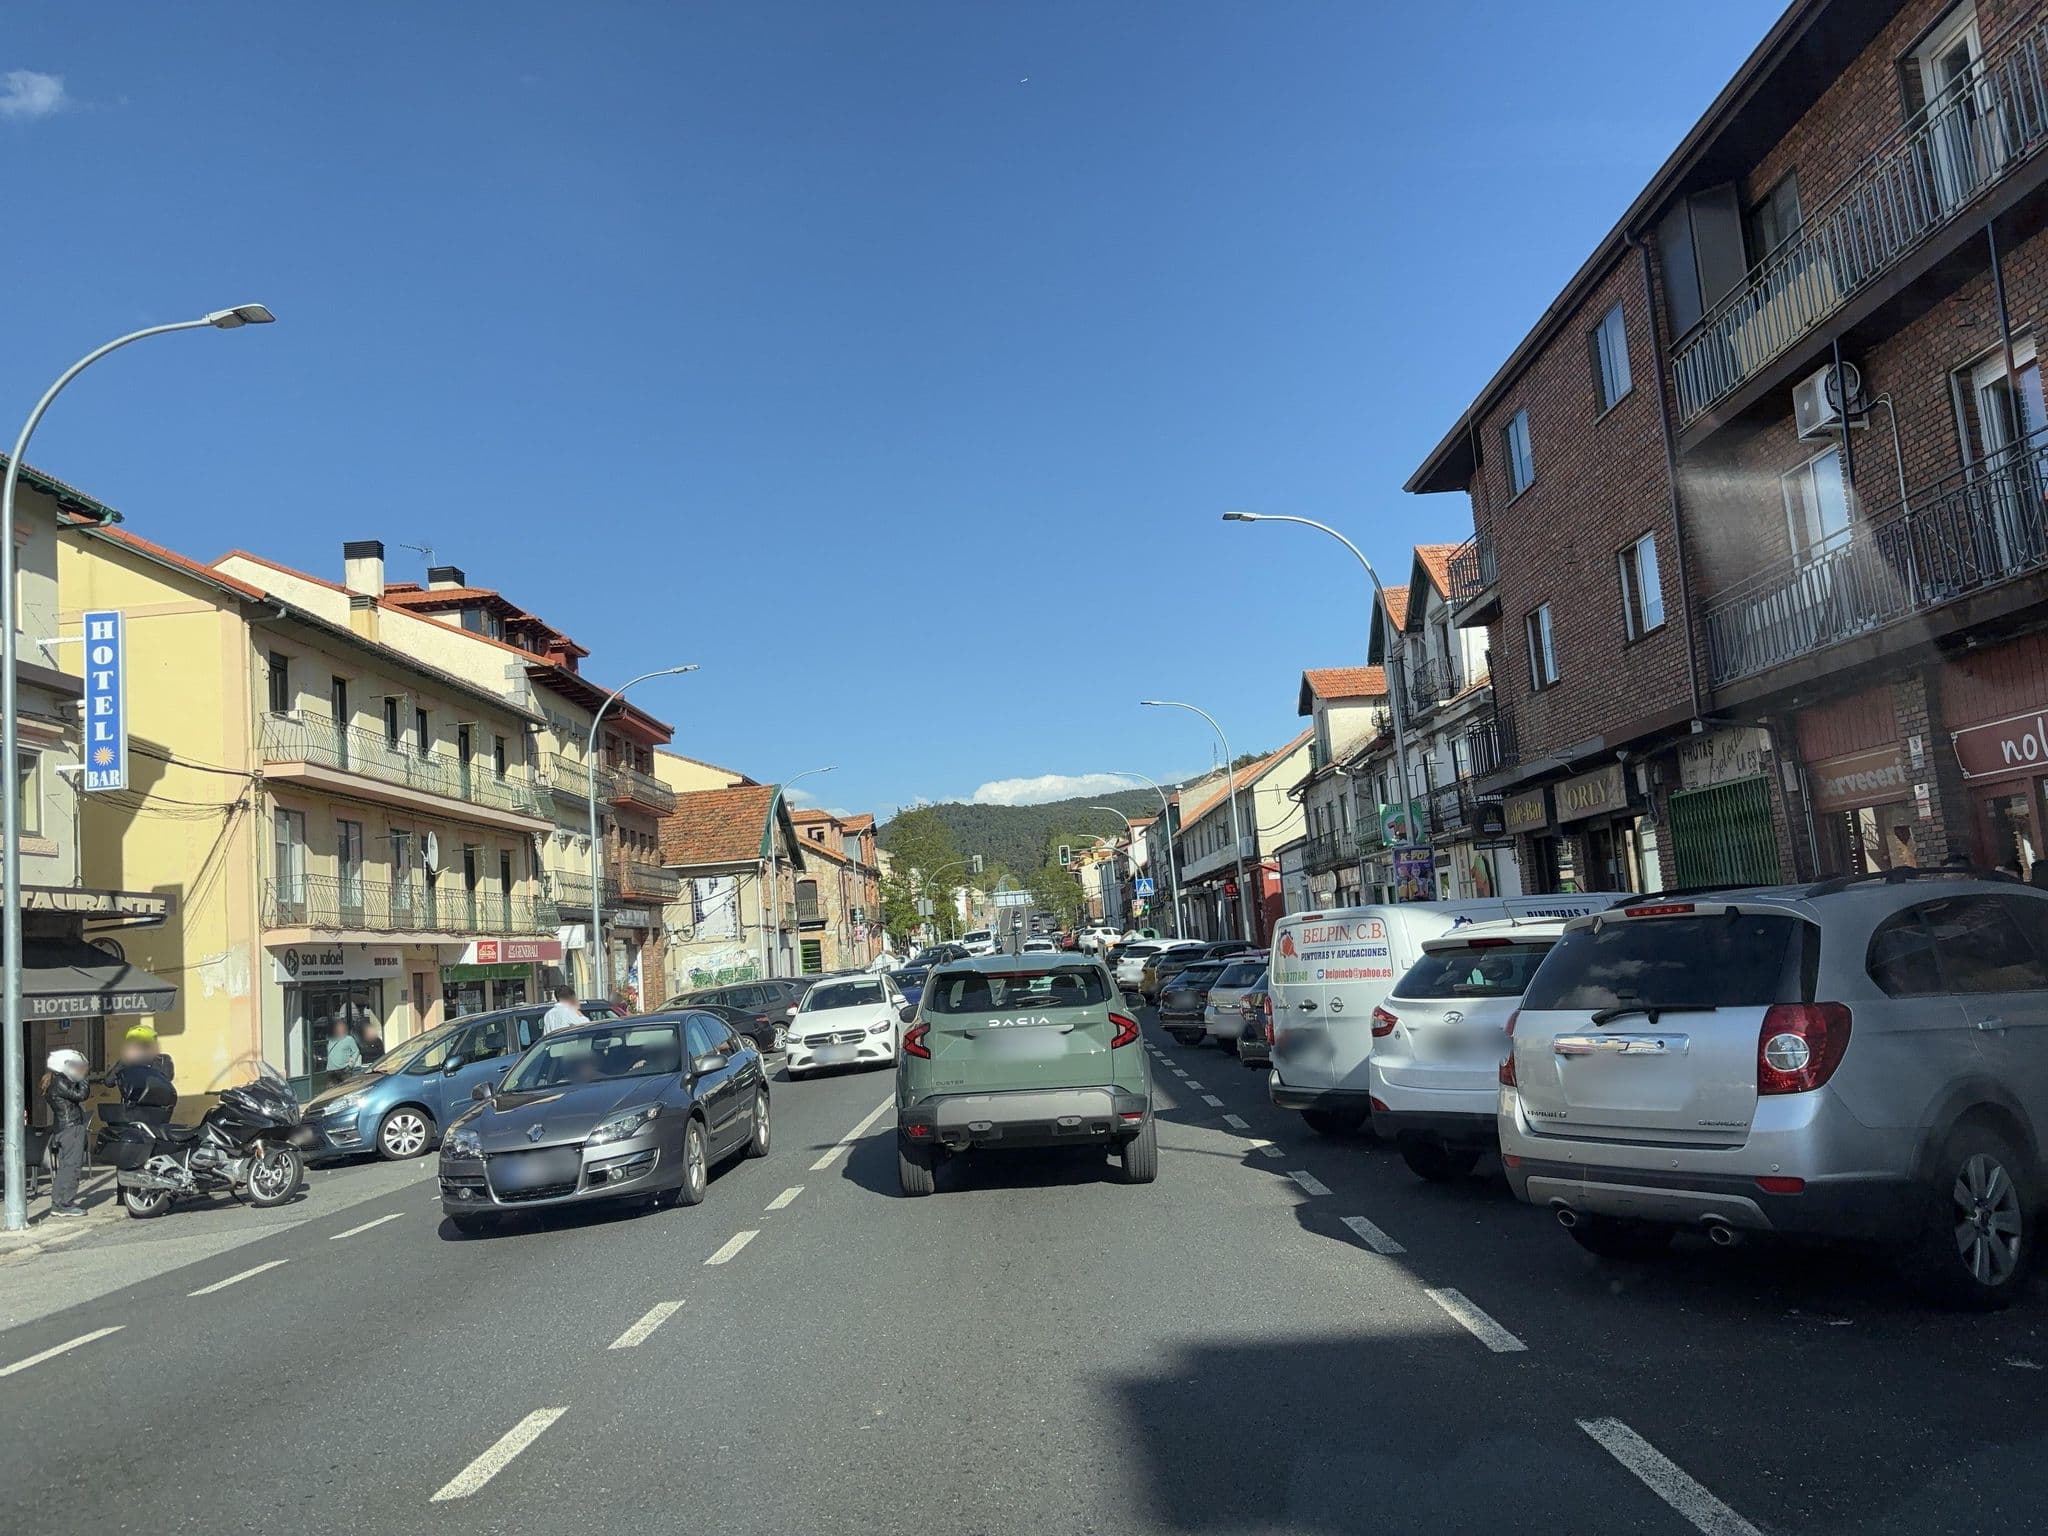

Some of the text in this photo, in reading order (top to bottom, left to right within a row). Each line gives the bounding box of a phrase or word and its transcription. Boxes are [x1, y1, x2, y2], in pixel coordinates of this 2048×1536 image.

[90, 620, 115, 741] HOTEL
[88, 770, 120, 788] BAR
[1567, 778, 1609, 812] ORLY
[1400, 850, 1430, 862] K-POP
[0, 889, 166, 915] TAURANTE
[1303, 922, 1386, 944] BELPIN, C.B.
[1301, 947, 1388, 961] PINTURAS Y APLICACIONES
[1325, 967, 1392, 979] belpincb@yahoo.es
[33, 993, 149, 1014] HOTEL LUCÍA
[988, 1016, 1050, 1027] DACIA
